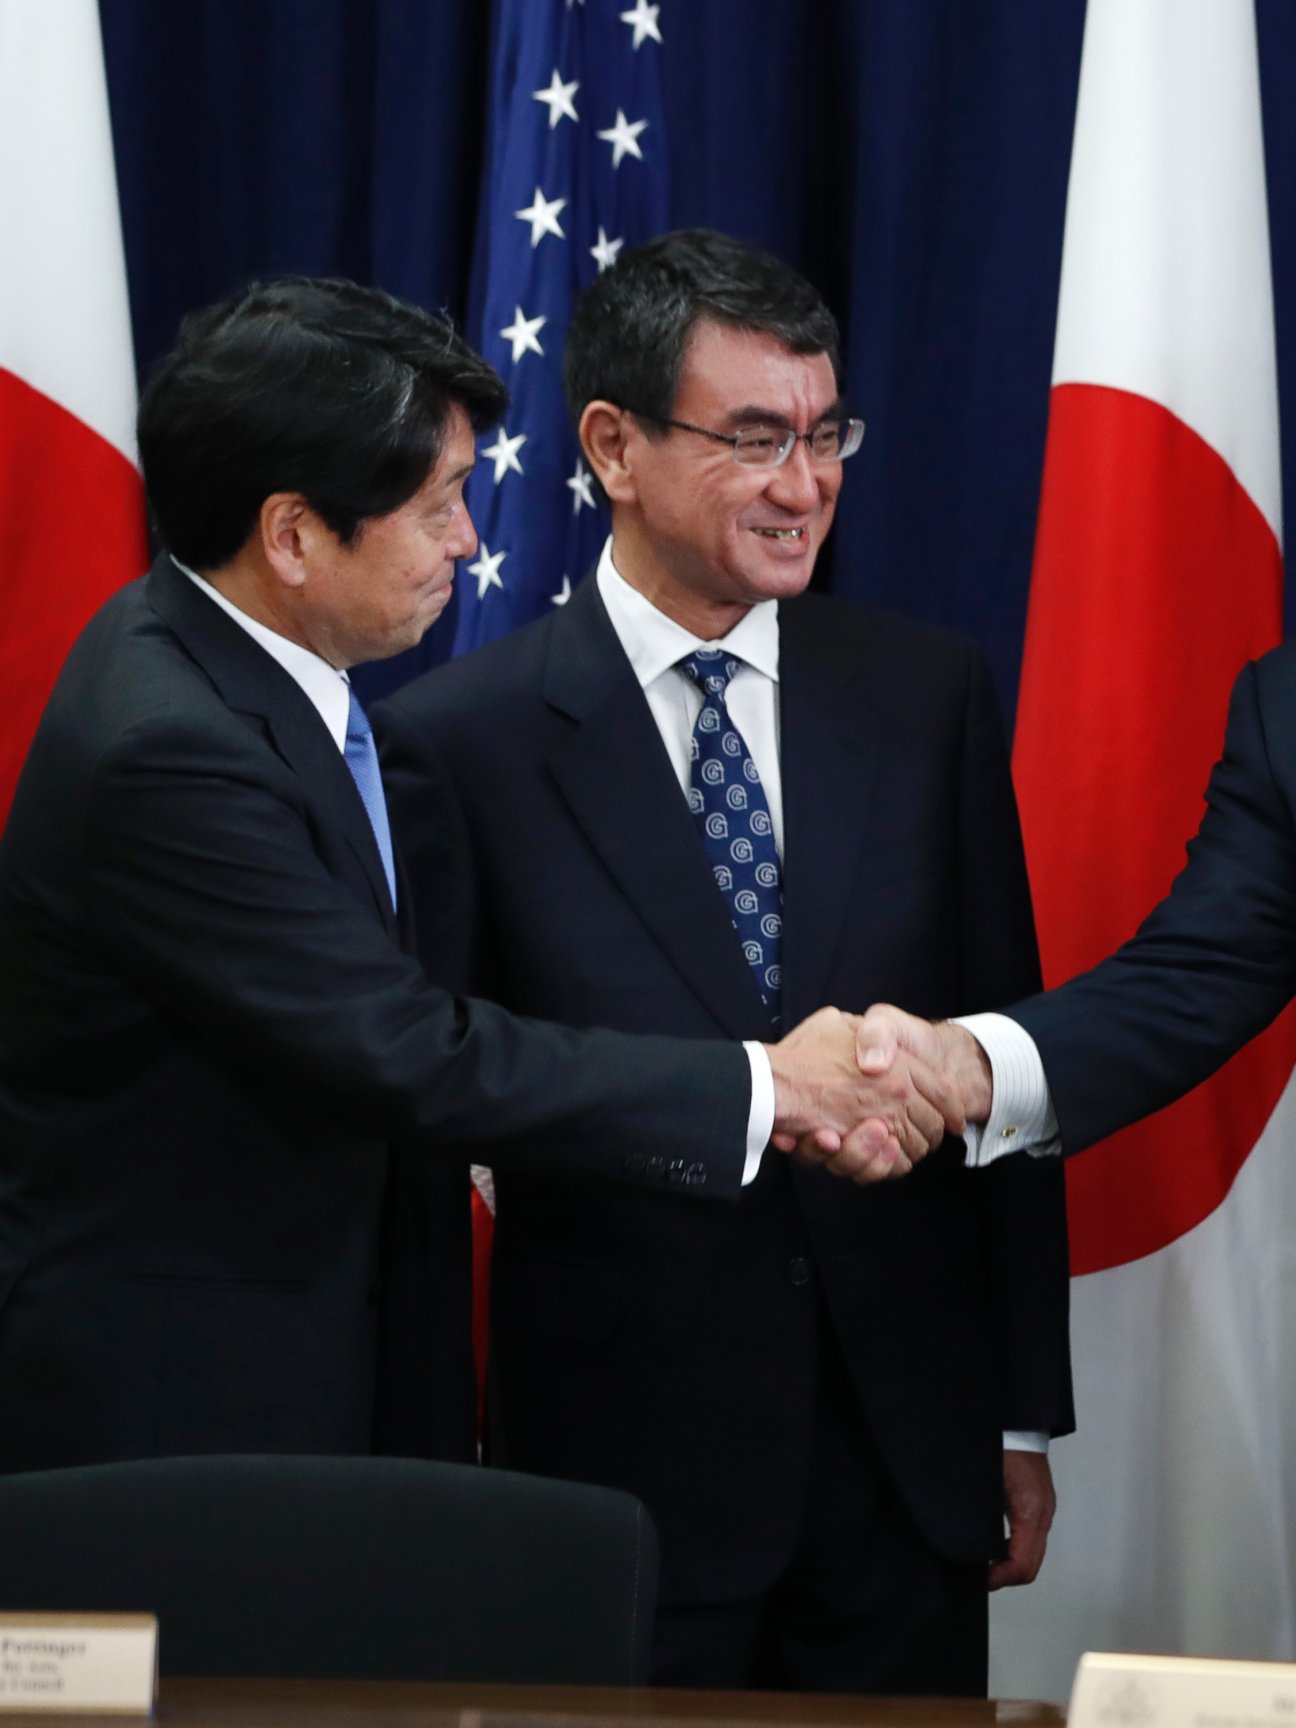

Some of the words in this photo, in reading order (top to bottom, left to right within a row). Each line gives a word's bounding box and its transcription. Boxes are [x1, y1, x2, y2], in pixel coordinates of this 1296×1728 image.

[722, 731, 741, 757] G
[701, 758, 724, 785] G
[726, 783, 747, 811] G
[705, 812, 728, 839] G
[749, 810, 771, 836] G
[730, 837, 753, 863] G
[755, 862, 778, 887] G
[734, 890, 758, 914] G
